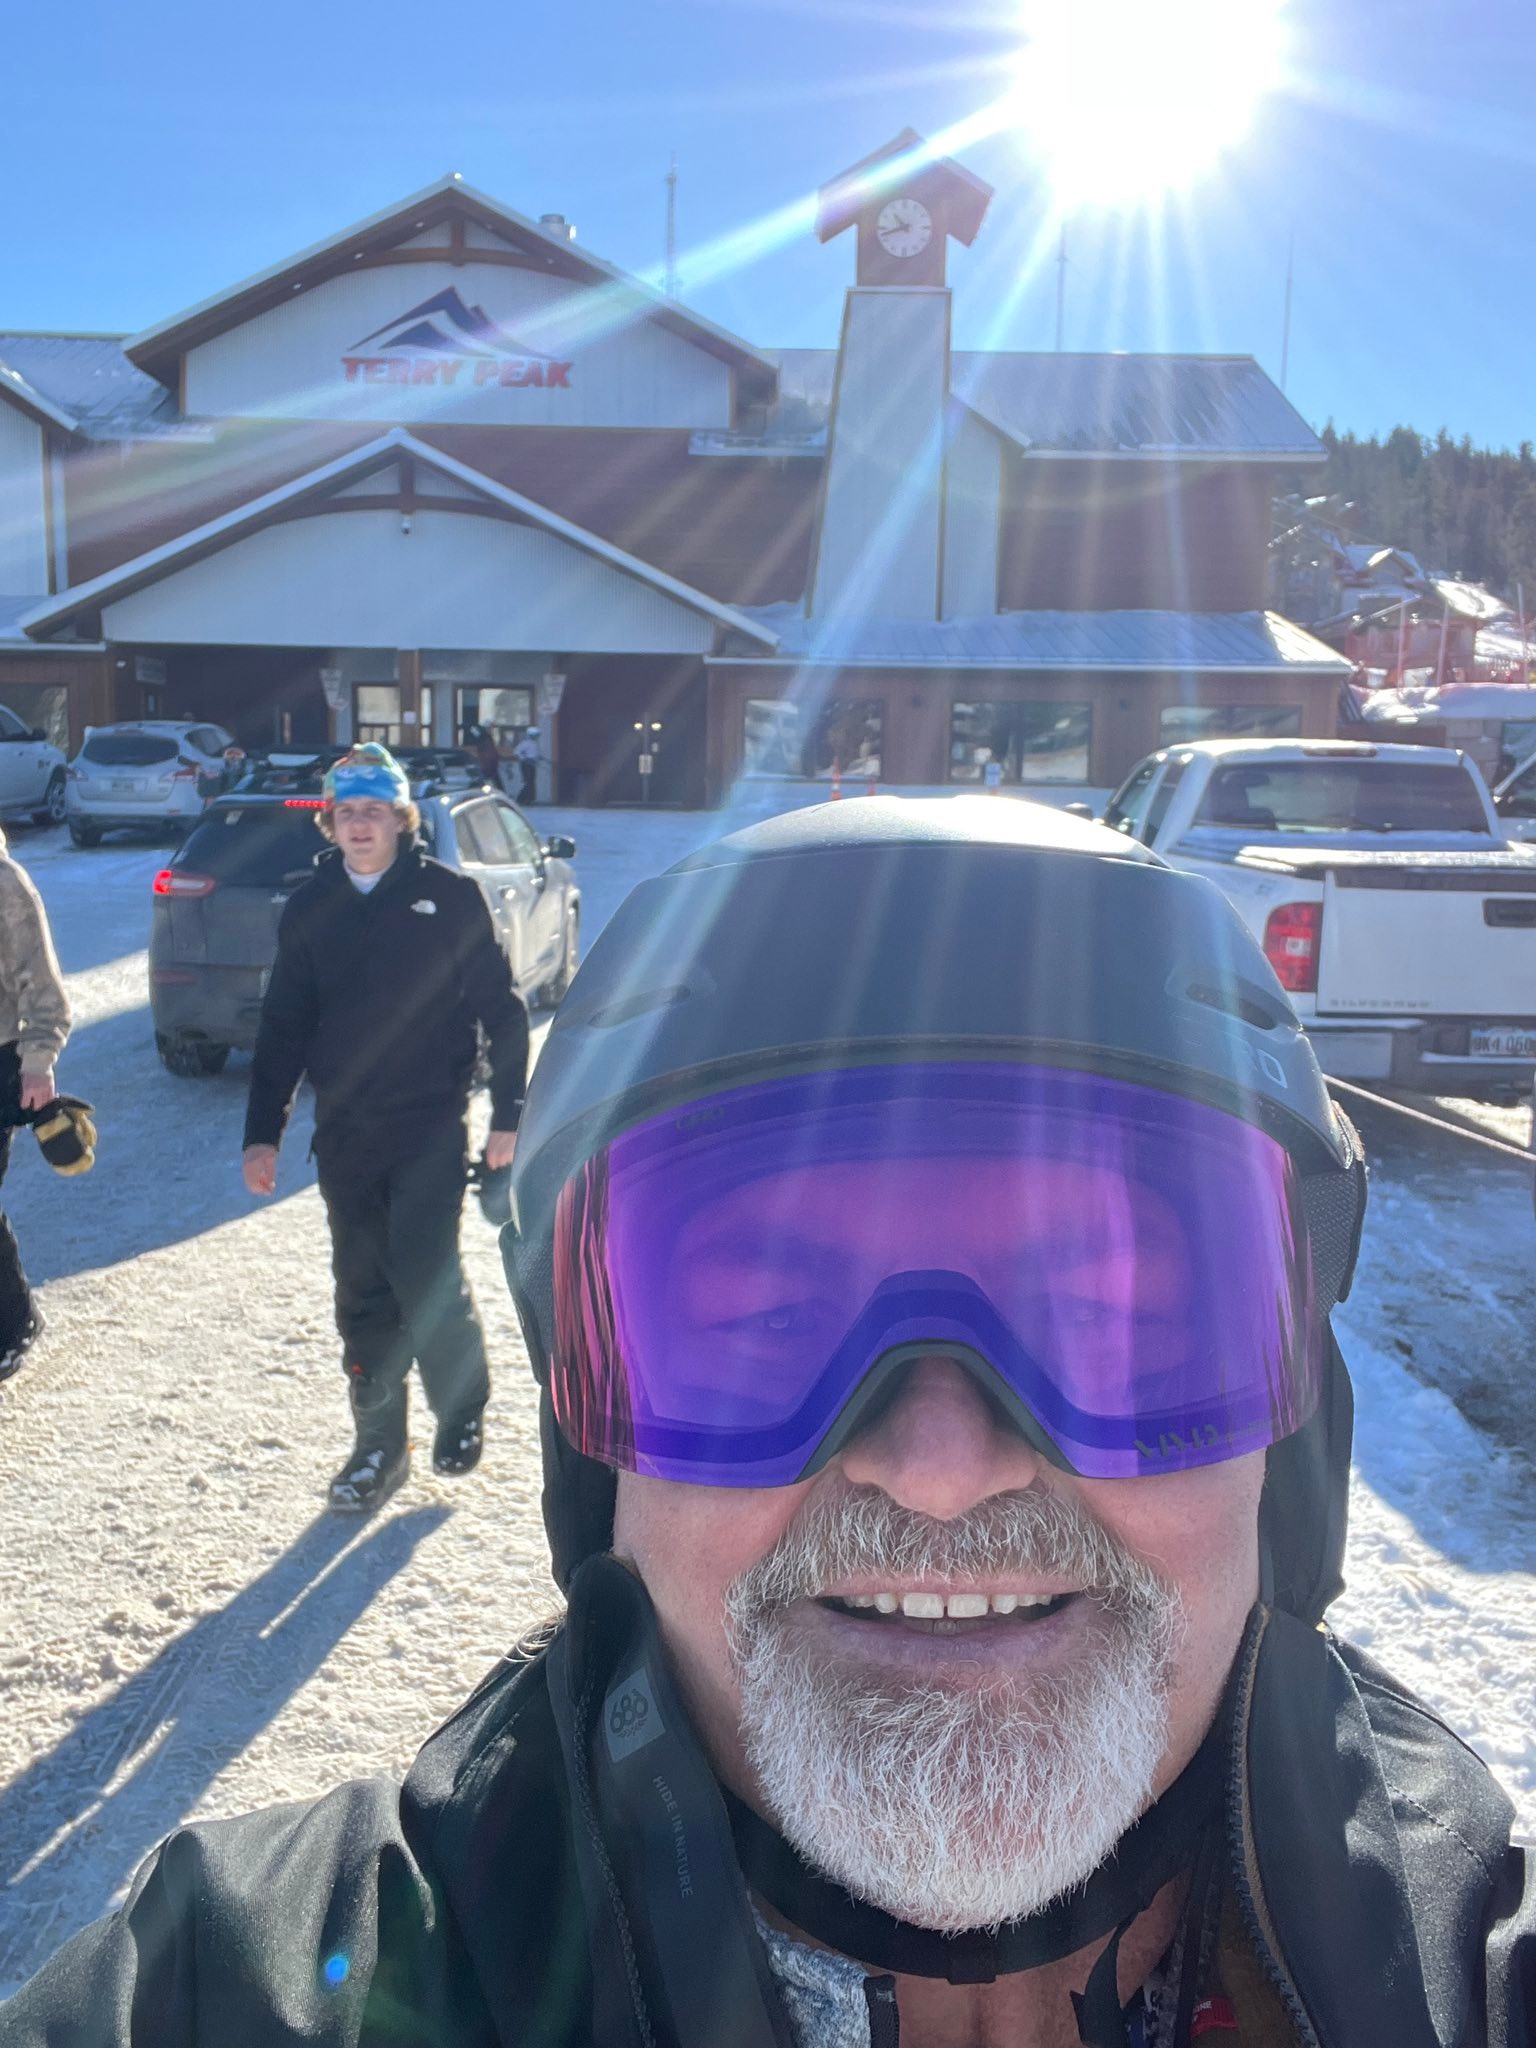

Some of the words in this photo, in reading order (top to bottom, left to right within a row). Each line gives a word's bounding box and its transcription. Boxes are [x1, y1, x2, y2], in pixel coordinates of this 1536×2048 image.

[341, 357, 463, 385] TERRY
[474, 359, 575, 388] PEAK
[652, 1775, 679, 1813] HIDE
[671, 1814, 685, 1834] IN
[675, 1835, 694, 1898] NATURE
